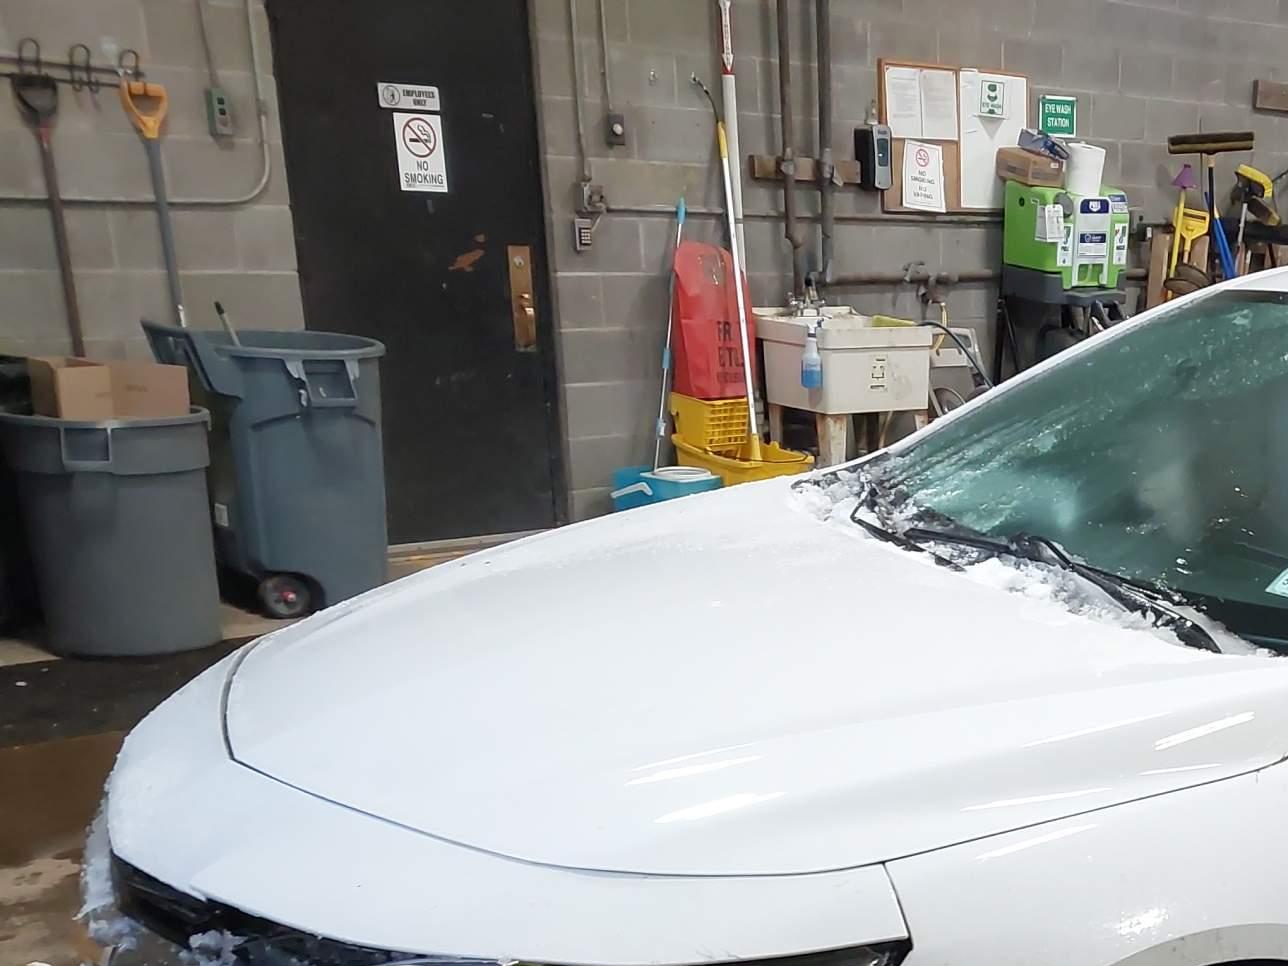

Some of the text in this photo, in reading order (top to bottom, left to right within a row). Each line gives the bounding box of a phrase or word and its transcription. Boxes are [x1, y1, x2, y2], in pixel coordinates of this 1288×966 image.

[402, 88, 436, 99] EMPLOYEES
[412, 98, 427, 107] ONLY
[1045, 103, 1072, 115] EYE WASH
[1047, 117, 1070, 128] STATION
[416, 160, 429, 171] NO
[404, 172, 444, 185] SMOKING
[918, 169, 927, 177] NO
[910, 175, 935, 185] SMOKING
